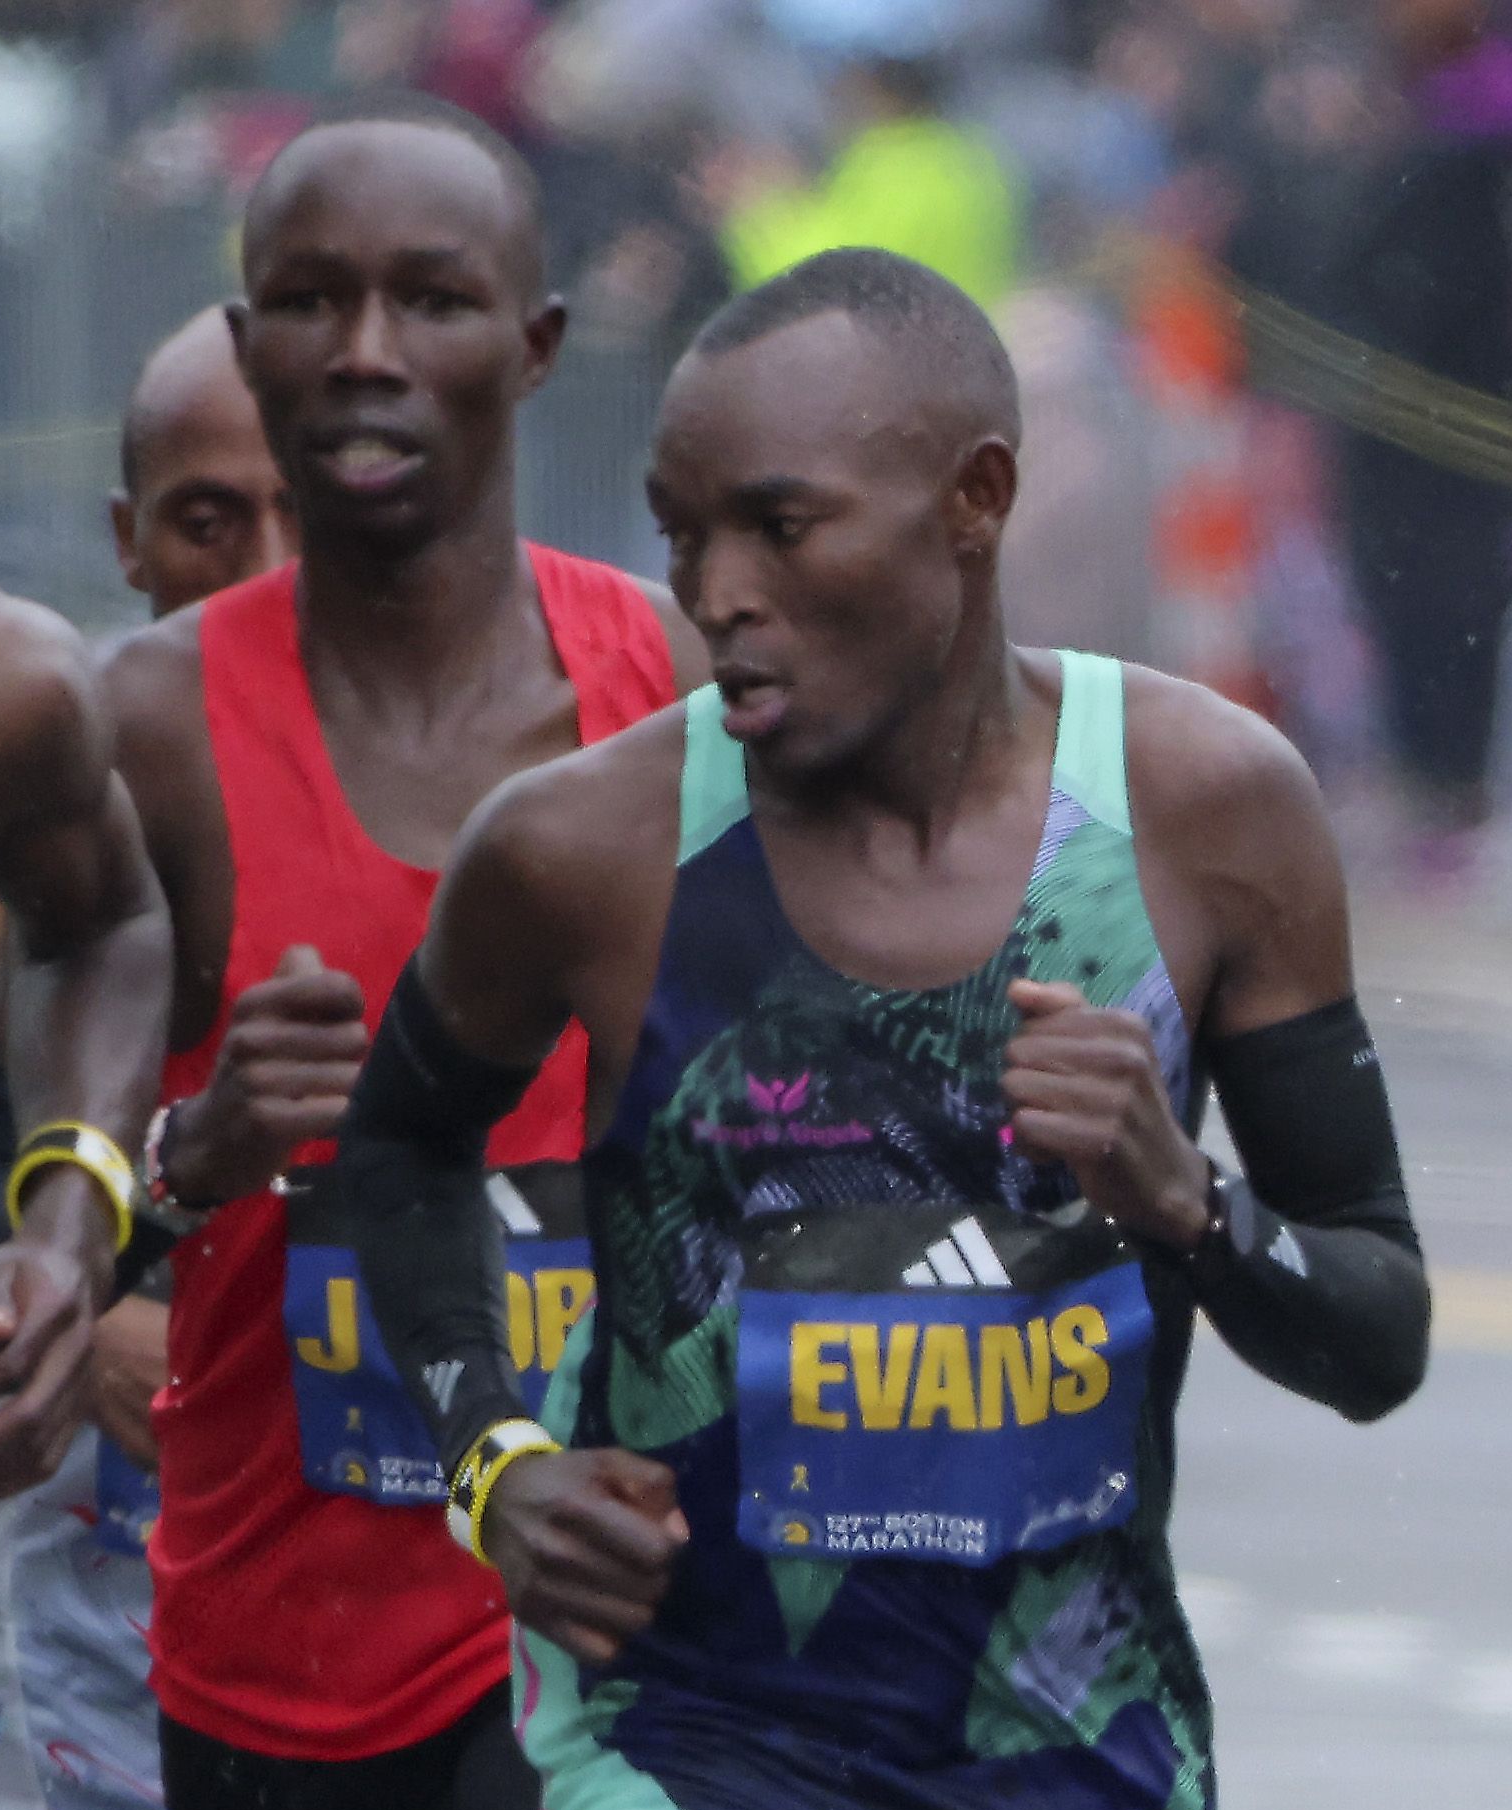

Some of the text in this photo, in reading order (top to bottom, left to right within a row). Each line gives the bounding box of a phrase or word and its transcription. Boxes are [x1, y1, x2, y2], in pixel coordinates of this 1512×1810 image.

[791, 1304, 1110, 1430] EVANS
[886, 1513, 984, 1535] BOSTON
[826, 1533, 985, 1554] MARATHON
